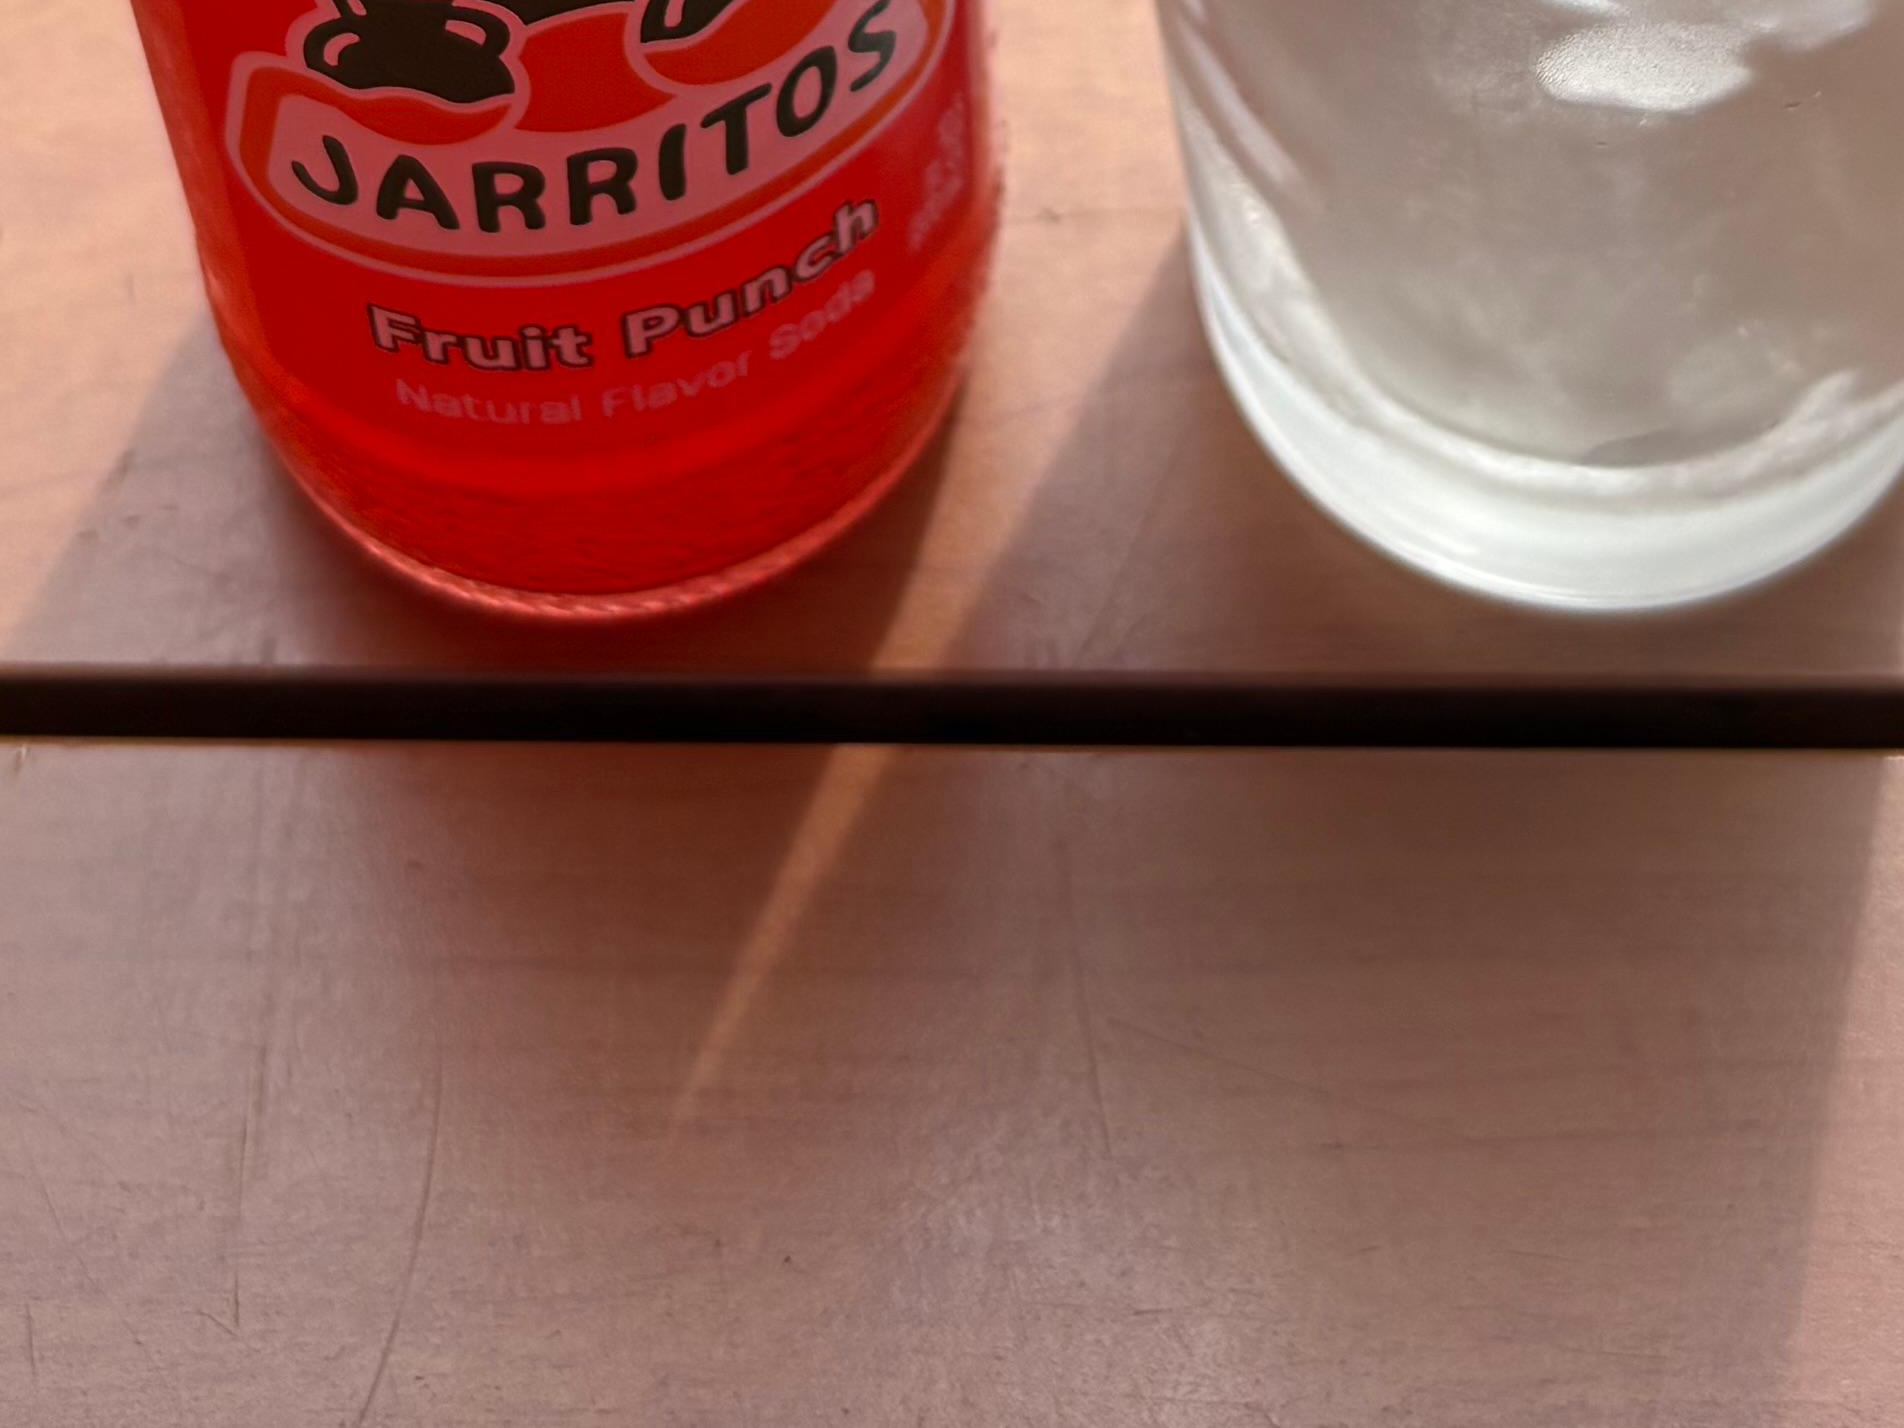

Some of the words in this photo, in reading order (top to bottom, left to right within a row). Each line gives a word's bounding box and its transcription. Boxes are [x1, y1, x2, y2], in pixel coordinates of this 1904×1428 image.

[366, 302, 593, 371] Fruit
[620, 198, 879, 360] Punch
[396, 377, 582, 425] Natural
[602, 349, 753, 420] Flavor
[768, 268, 877, 362] Soda
